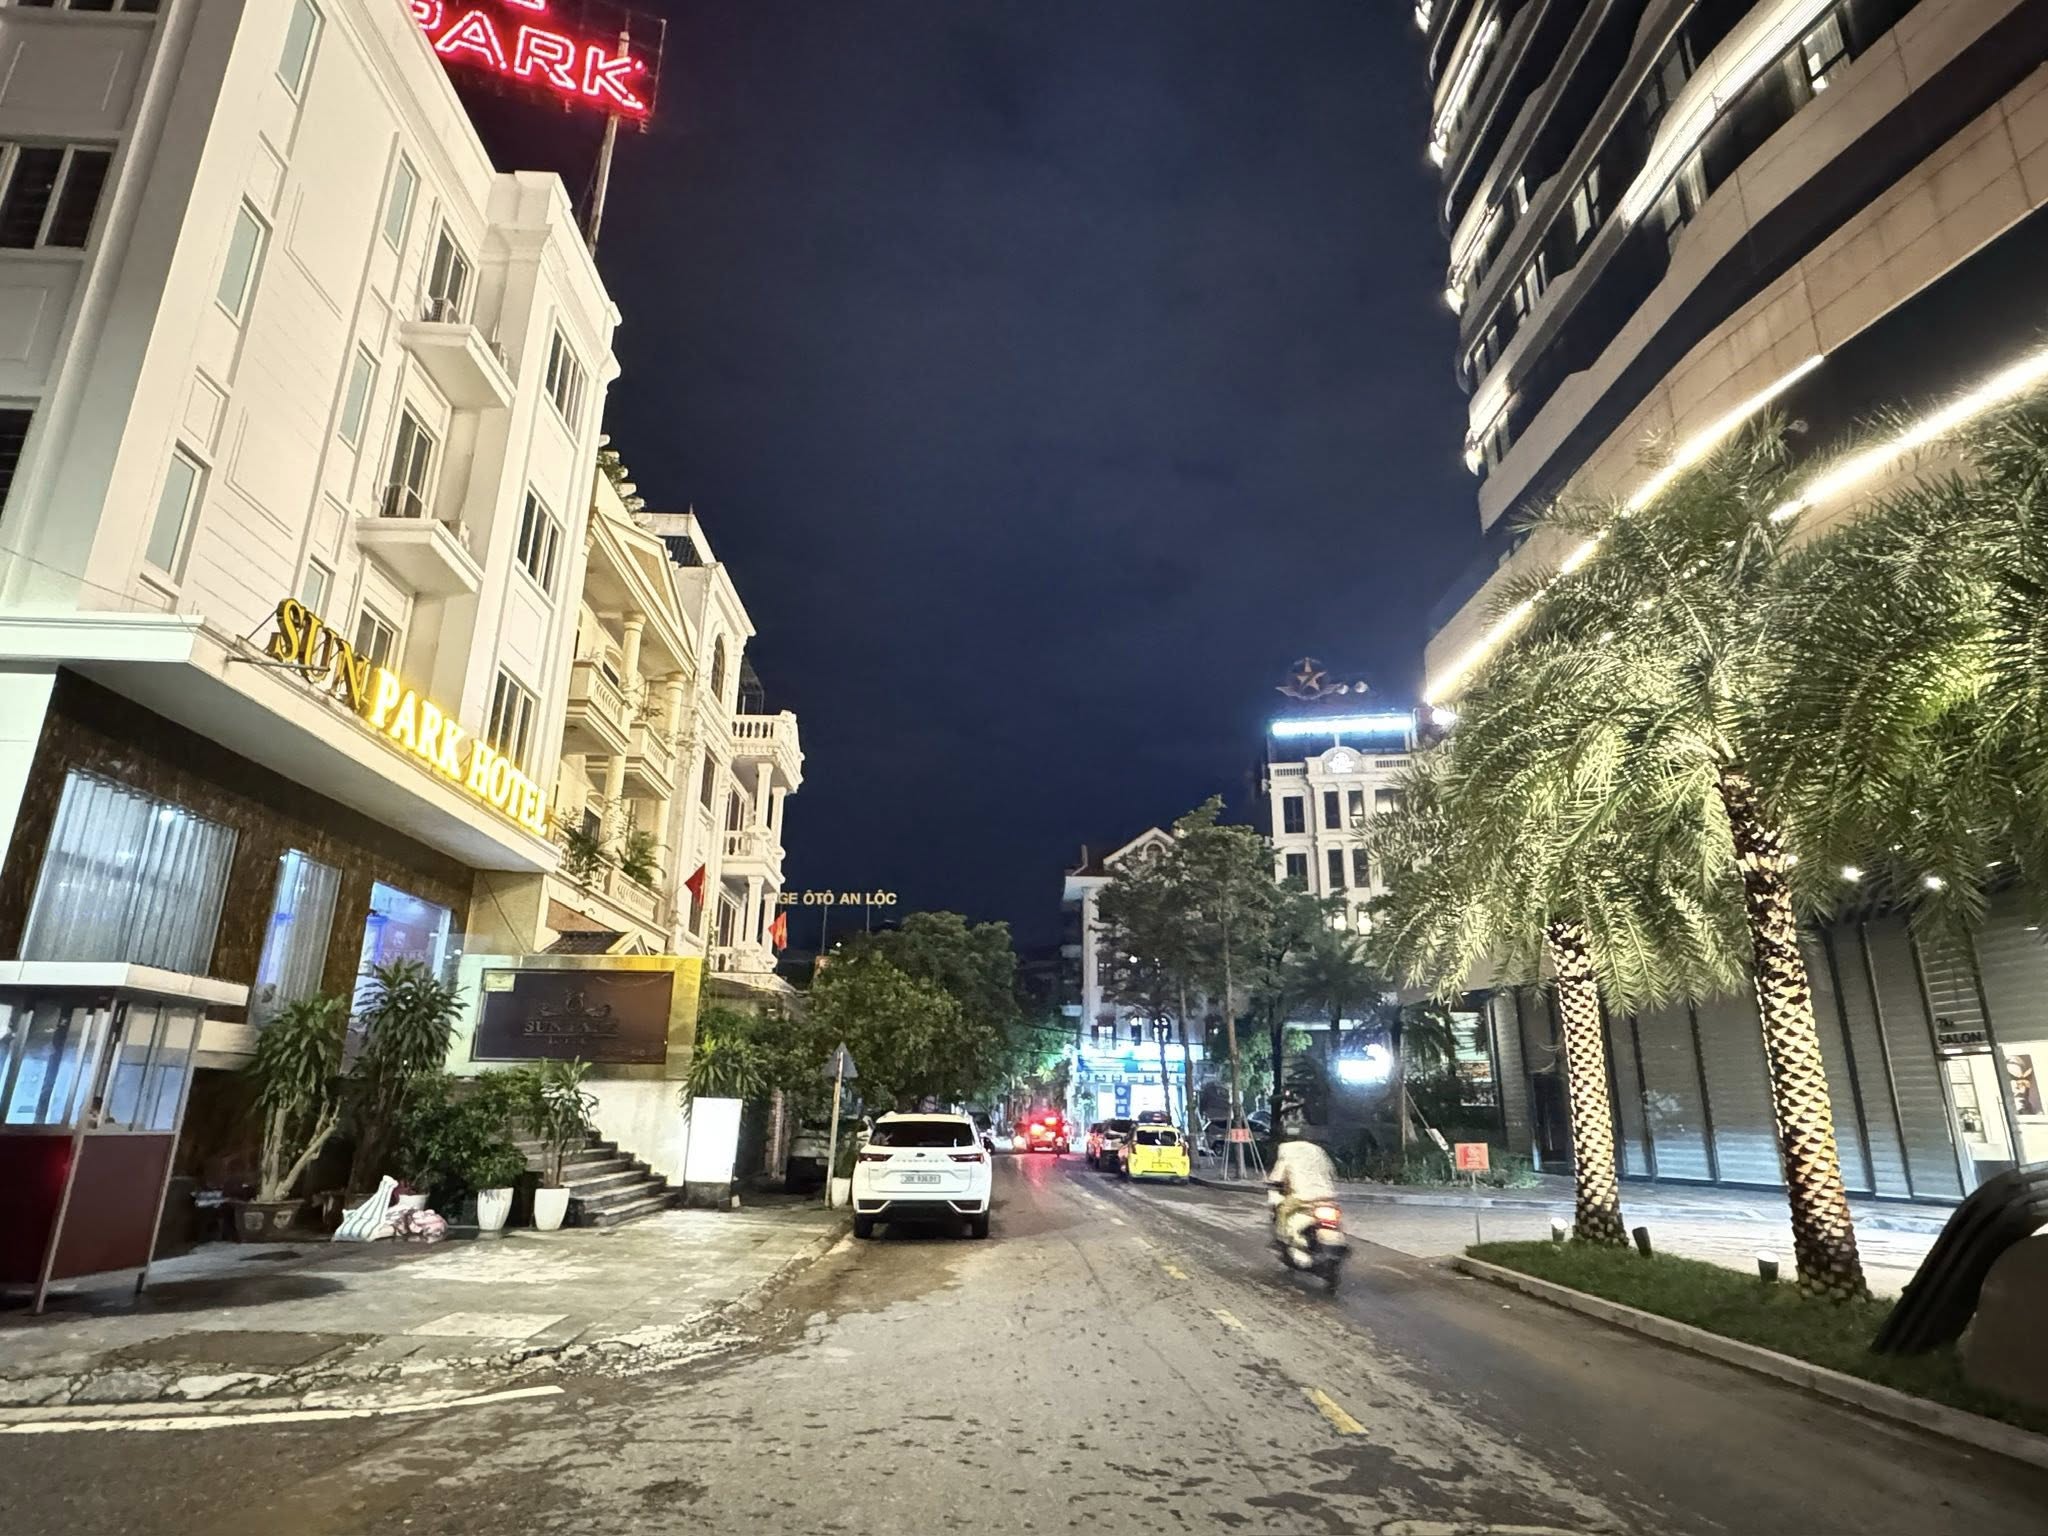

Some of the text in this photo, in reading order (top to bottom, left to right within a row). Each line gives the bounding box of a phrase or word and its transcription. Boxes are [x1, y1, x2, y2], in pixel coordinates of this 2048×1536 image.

[267, 597, 549, 837] SUN PARK HOTEL
[802, 889, 834, 905] ÔTÔ
[839, 892, 861, 905] AN
[865, 888, 897, 908] LỘC
[1938, 1031, 1983, 1044] SALON
